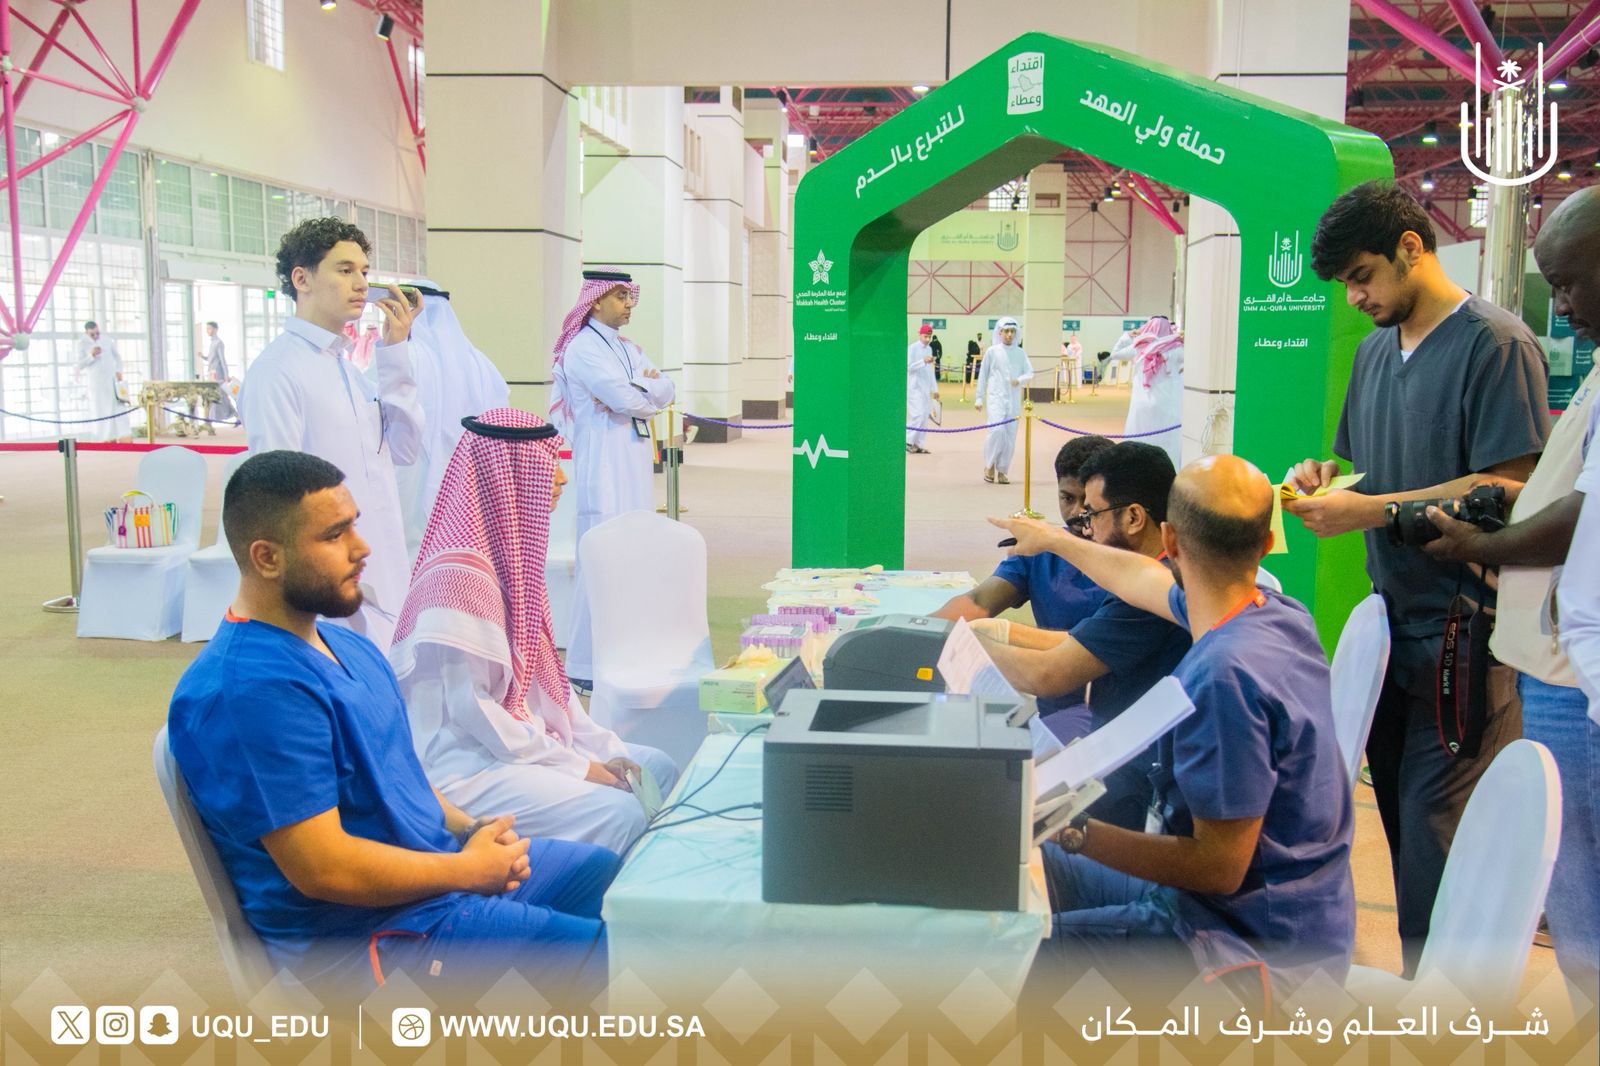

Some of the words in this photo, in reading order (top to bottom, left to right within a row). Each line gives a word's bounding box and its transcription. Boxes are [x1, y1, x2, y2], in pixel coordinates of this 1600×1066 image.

[1011, 55, 1043, 73] اقتداء
[1011, 93, 1042, 108] وعطاء
[1079, 89, 1137, 126] العهد
[915, 104, 965, 161] للتبرع
[1134, 115, 1174, 148] ولي
[1176, 125, 1226, 165] حملة
[855, 144, 913, 199] بالدم
[1243, 293, 1276, 305] القرى
[1286, 293, 1326, 303] جامعة
[1254, 338, 1282, 349] وعطاء
[1283, 338, 1308, 347] اقتداء
